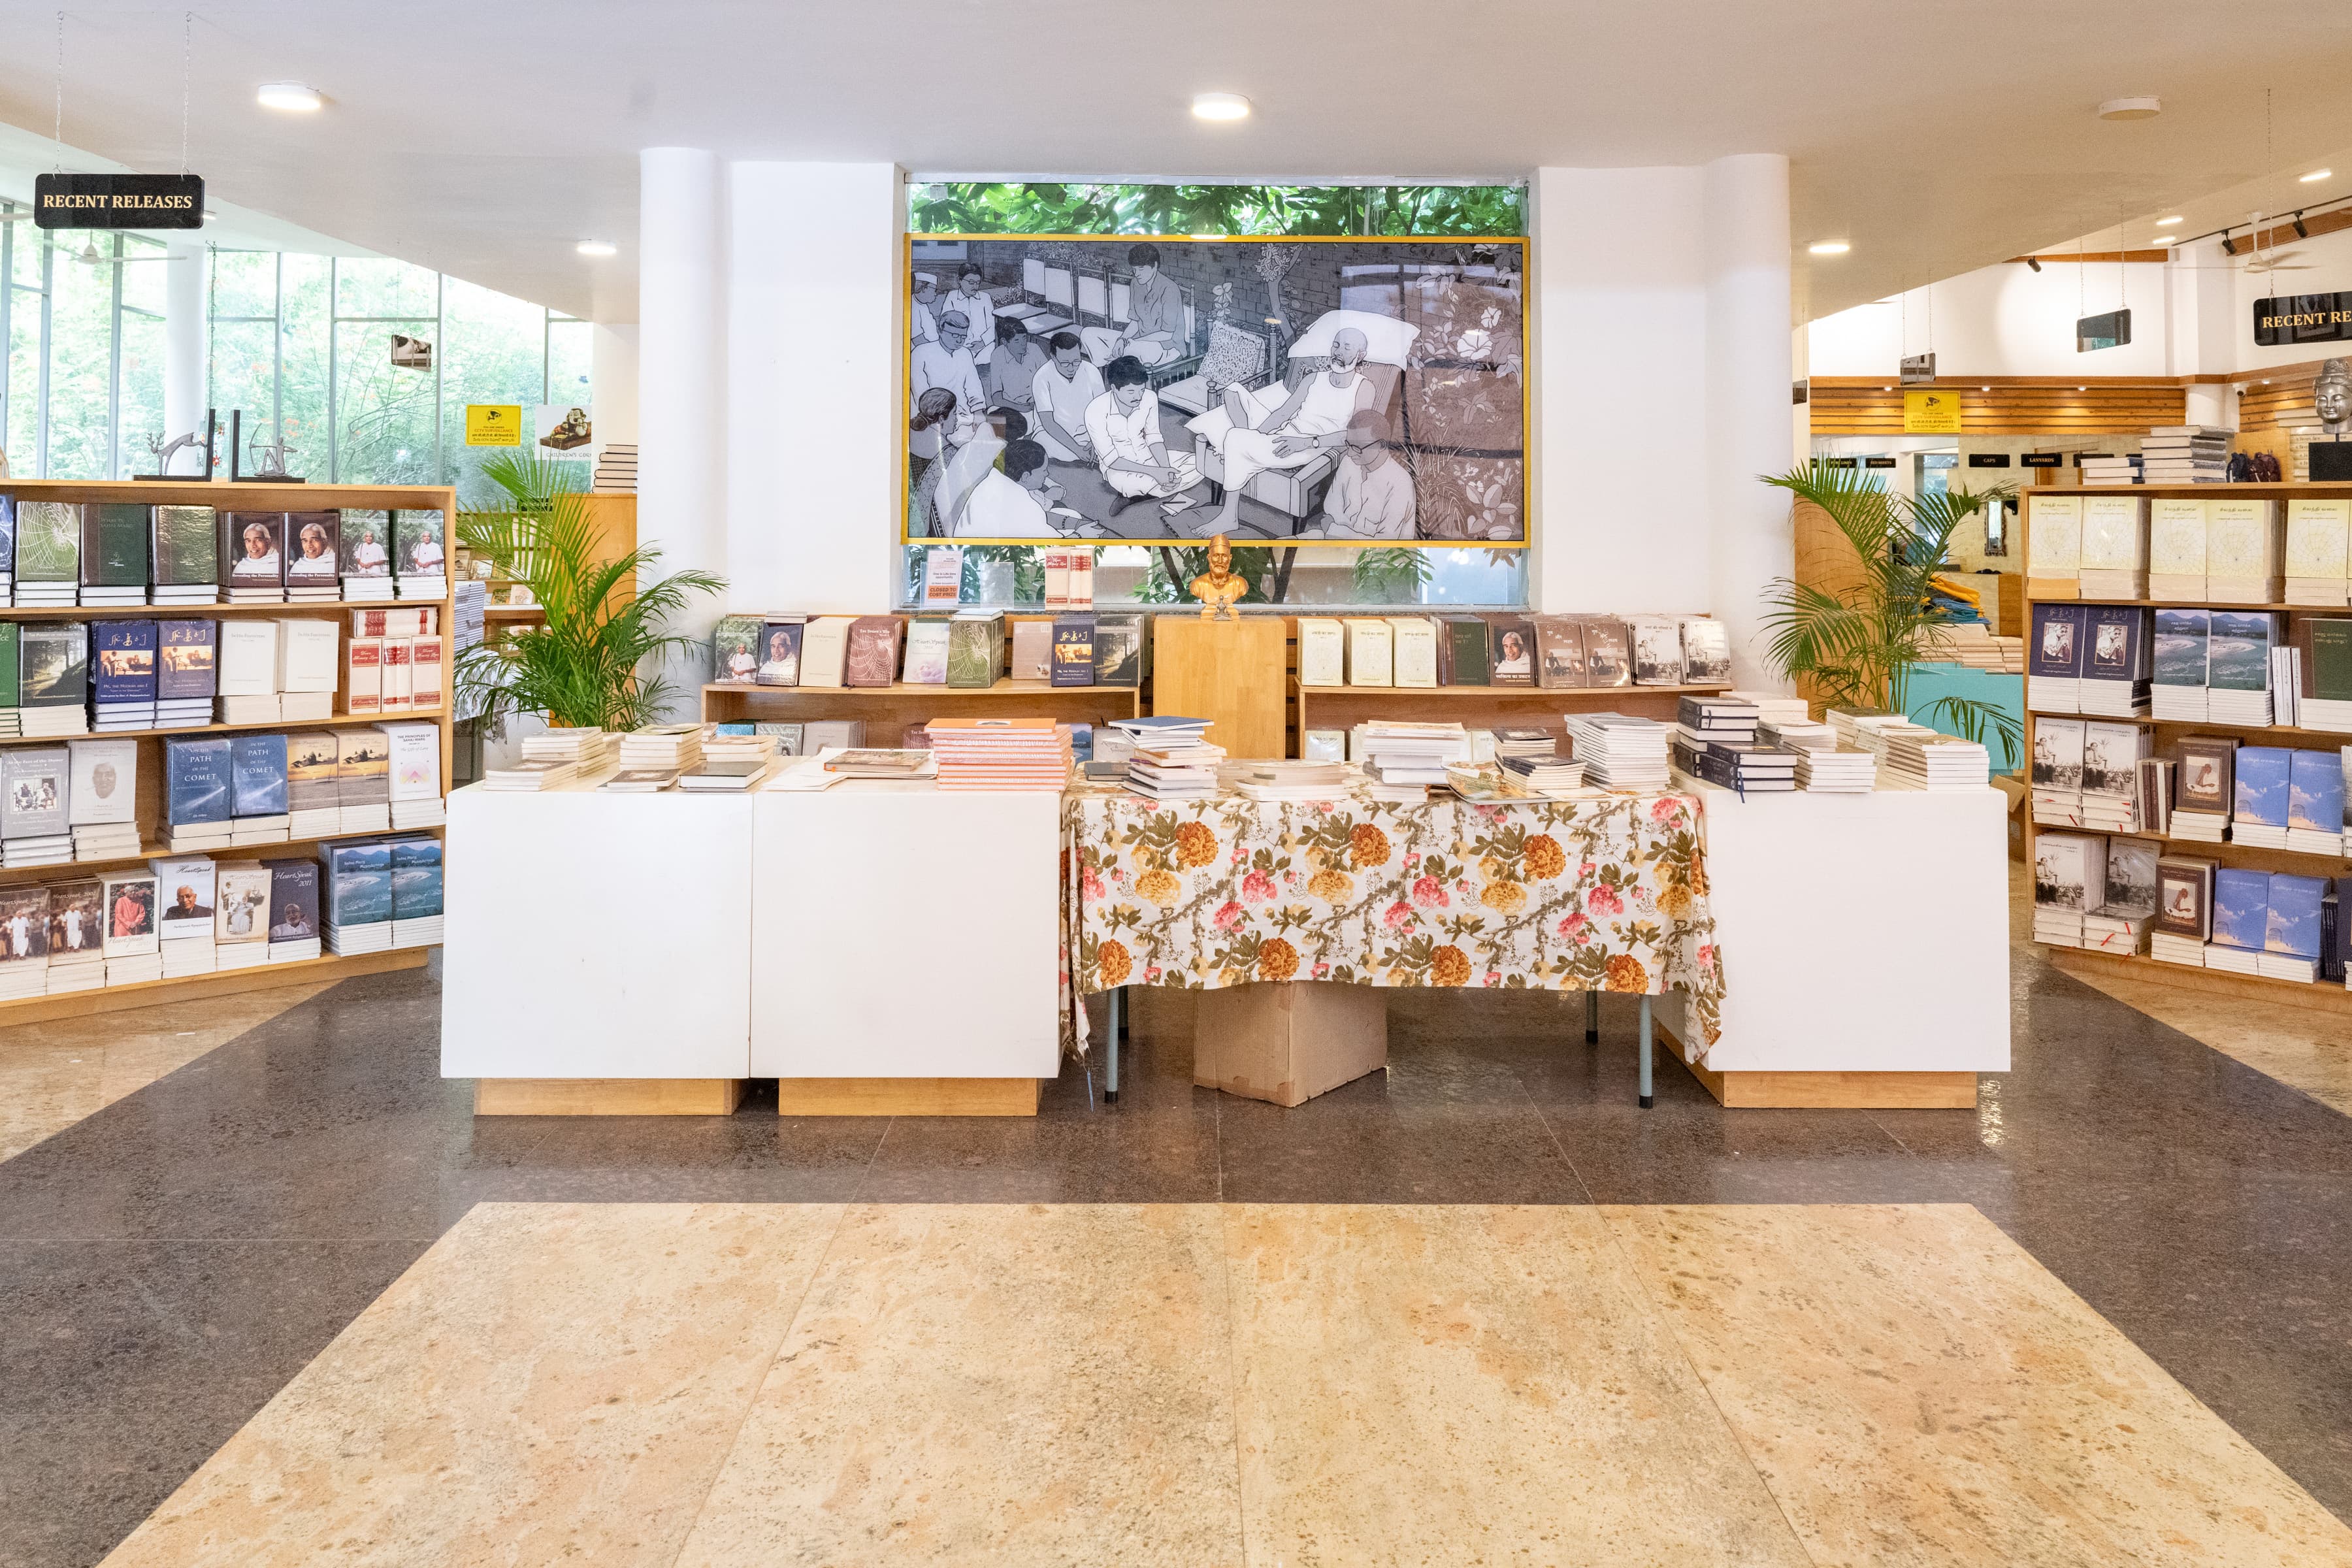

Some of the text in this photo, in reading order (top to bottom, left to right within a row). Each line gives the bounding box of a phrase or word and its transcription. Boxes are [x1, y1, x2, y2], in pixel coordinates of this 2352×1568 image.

[43, 195, 193, 208] RECENT RELEASES
[2262, 310, 2352, 328] RECENT RE
[177, 865, 212, 874] HeartSpeak
[274, 868, 313, 881] HeartSpeak
[52, 891, 82, 900] HeartSpeak
[108, 936, 144, 947] HeartSpeak
